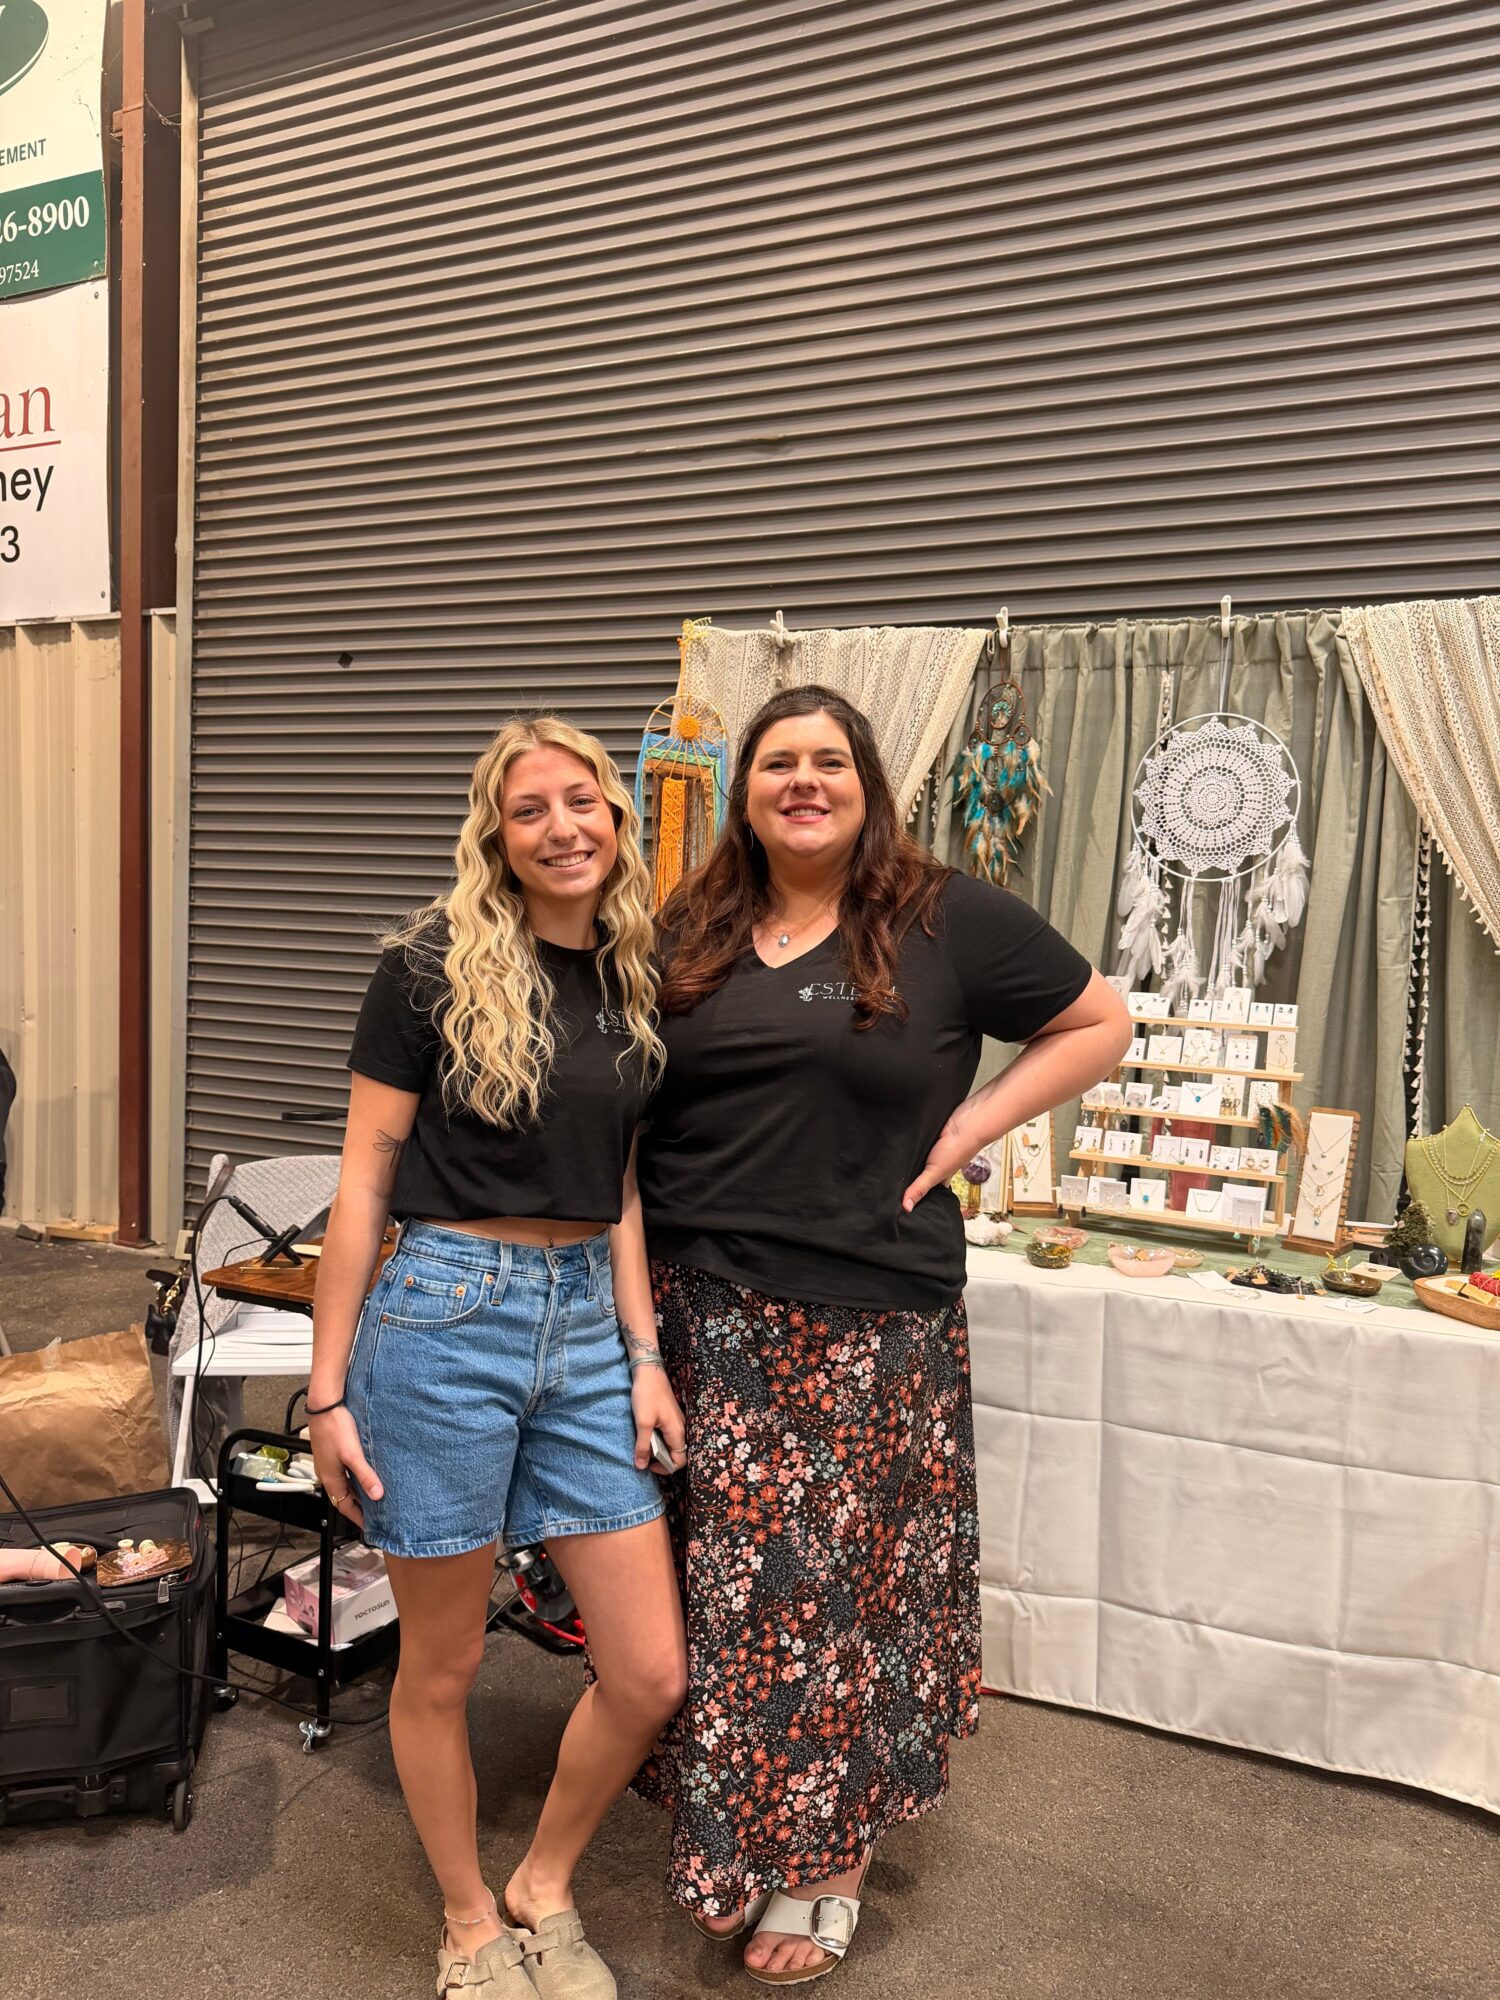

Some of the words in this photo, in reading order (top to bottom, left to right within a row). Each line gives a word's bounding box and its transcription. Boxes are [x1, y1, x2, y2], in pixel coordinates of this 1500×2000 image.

[0, 138, 47, 166] EMENT
[0, 195, 90, 243] 6-8900
[0, 259, 40, 285] 97524
[0, 525, 21, 563] 3
